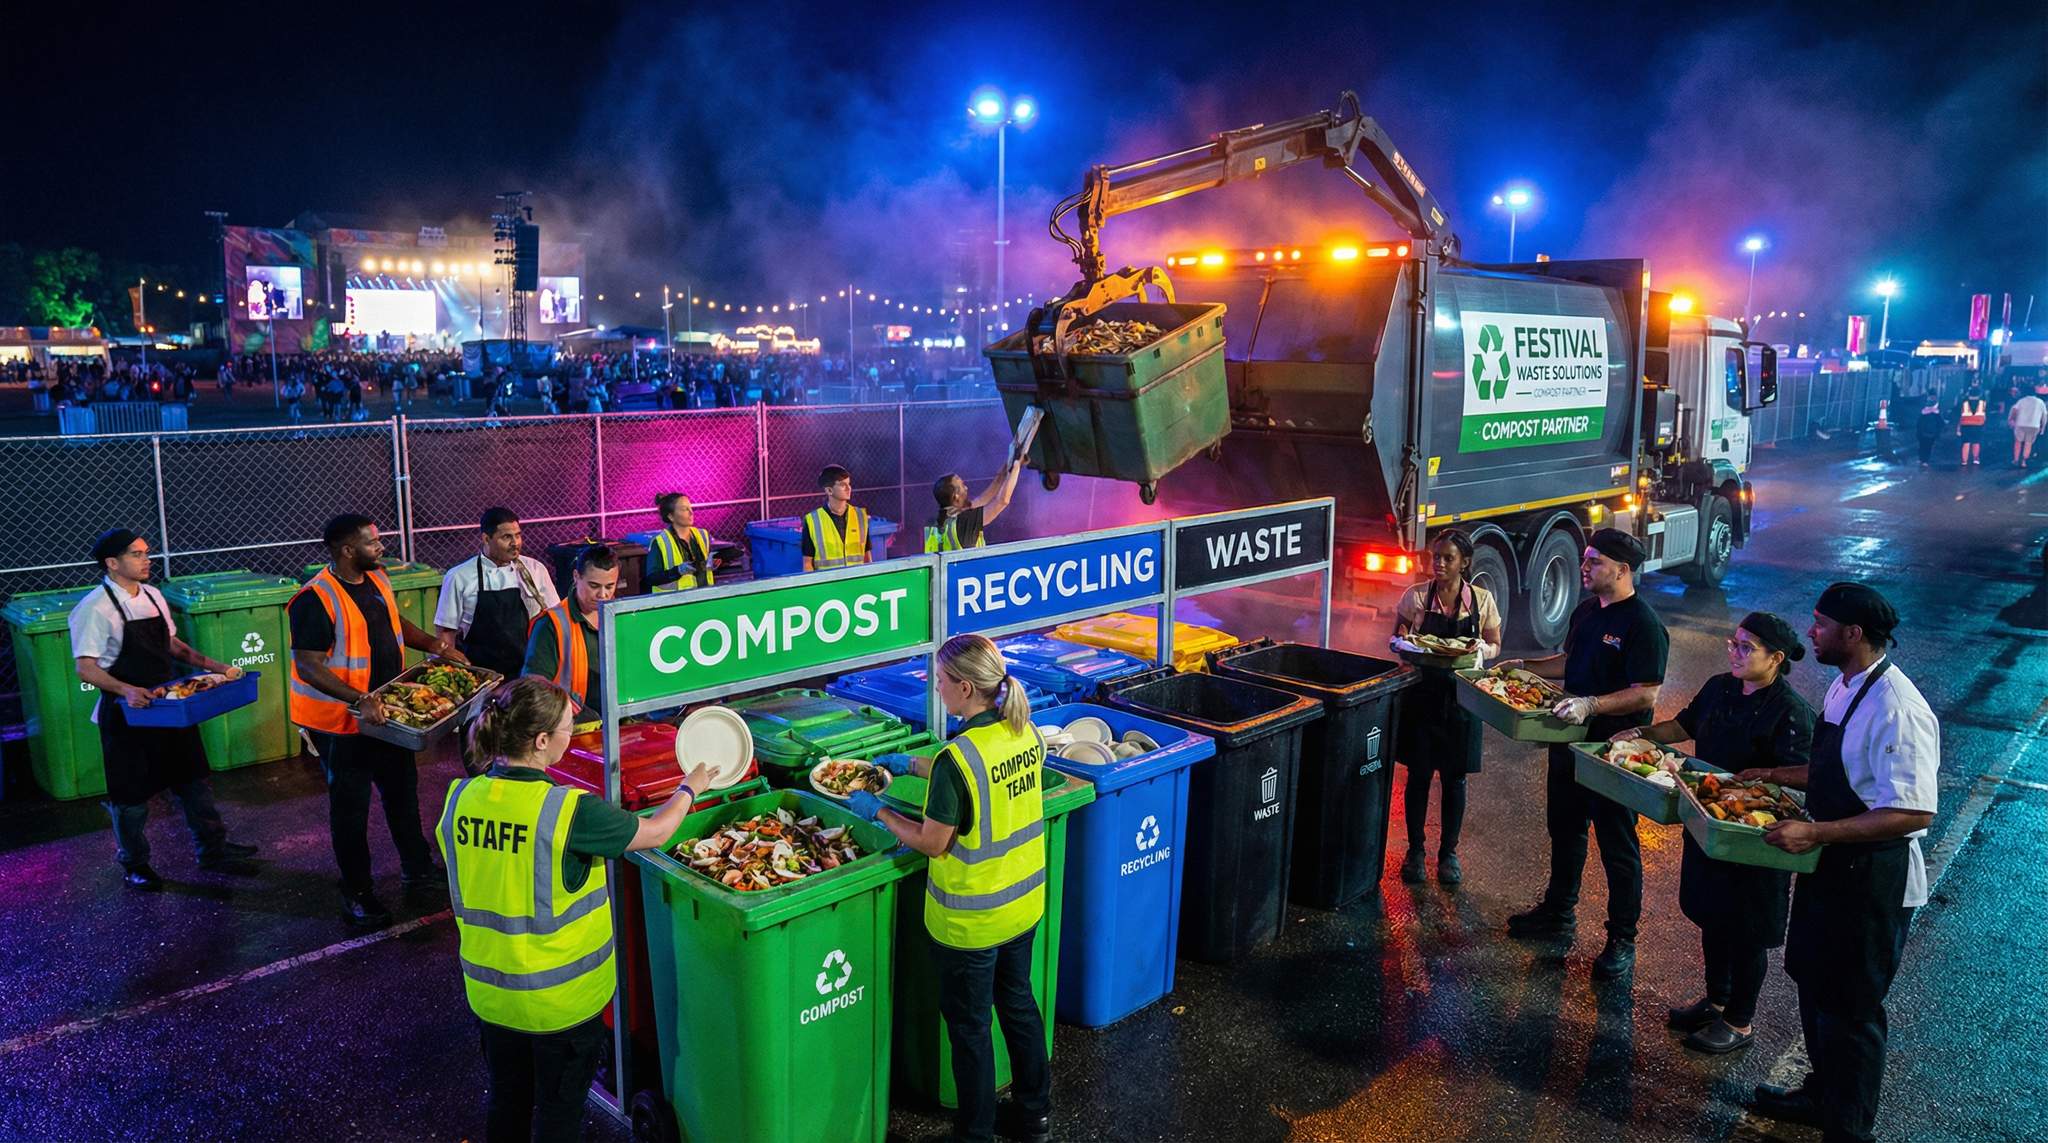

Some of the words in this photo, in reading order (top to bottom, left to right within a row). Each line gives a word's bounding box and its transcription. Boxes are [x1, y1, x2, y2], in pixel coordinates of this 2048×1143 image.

[1514, 327, 1603, 359] FESTIVAL
[1516, 365, 1550, 381] WASTE
[1552, 365, 1602, 380] SOLUTIONS
[1482, 419, 1540, 441] COMPOST
[1541, 415, 1589, 436] PARTNER
[1206, 522, 1302, 570] WASTE
[957, 547, 1155, 617] RECYCLING
[649, 588, 907, 674] COMPOST
[231, 652, 275, 668] COMPOST
[991, 745, 1040, 784] COMPOST
[1006, 771, 1036, 800] TEAM
[1254, 801, 1280, 821] WASTE
[457, 815, 528, 854] STAFF
[1121, 846, 1171, 877] RECYCLING
[800, 985, 865, 1025] COMPOST
